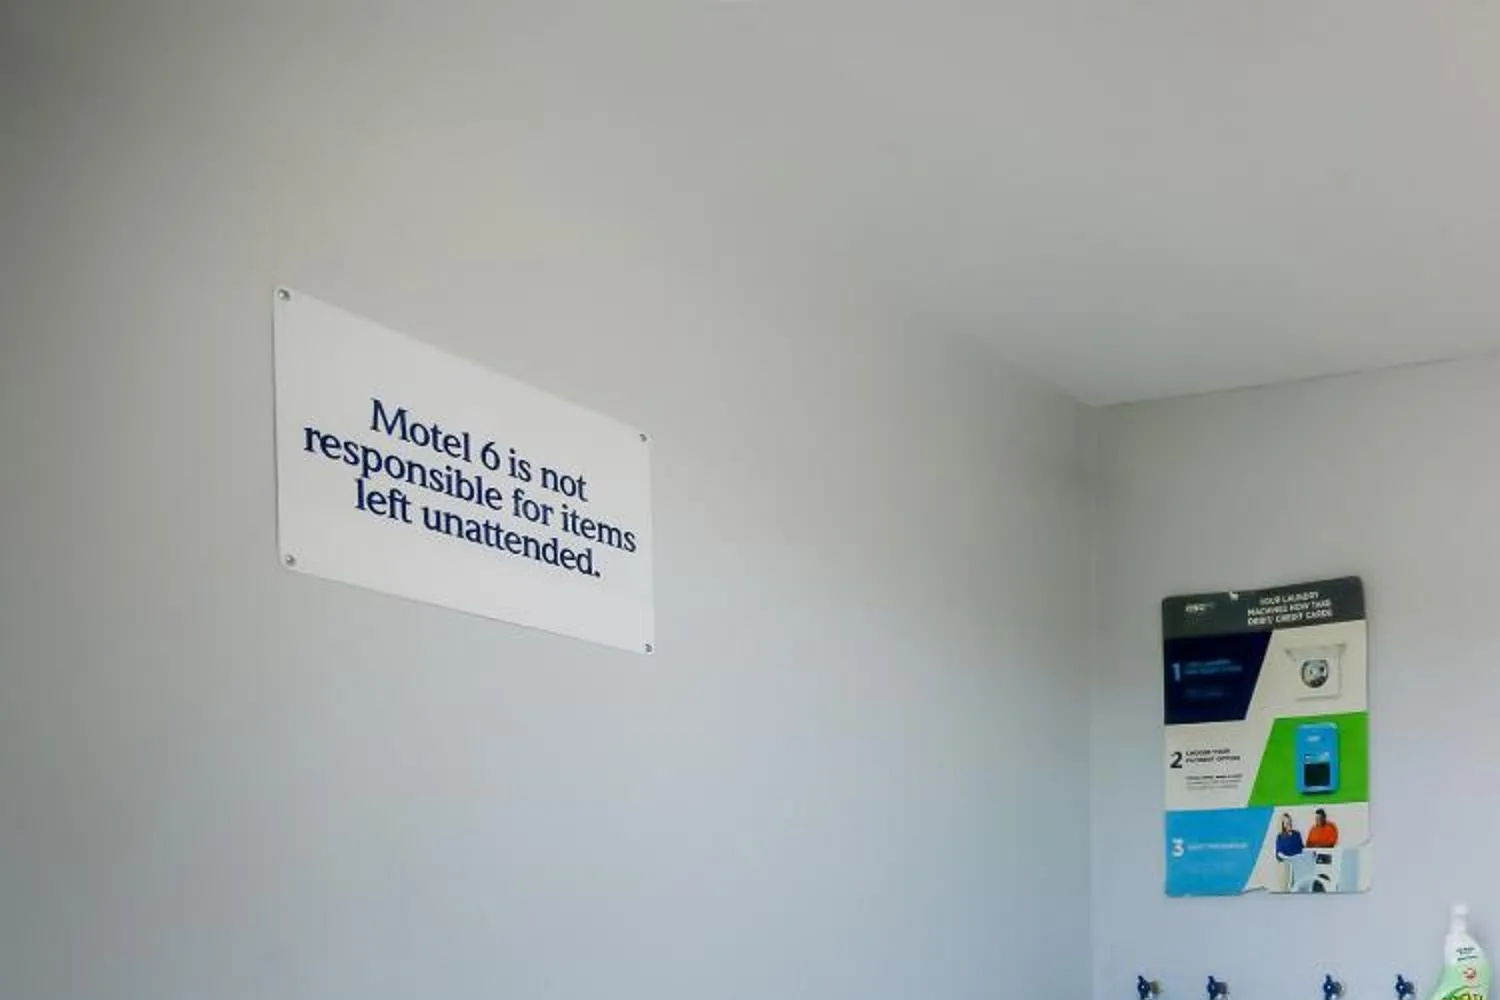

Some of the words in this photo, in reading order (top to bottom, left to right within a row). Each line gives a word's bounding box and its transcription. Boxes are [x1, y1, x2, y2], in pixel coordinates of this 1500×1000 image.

[370, 397, 471, 463] Motel
[481, 442, 501, 471] 6
[508, 449, 531, 483] is
[541, 465, 588, 502] not
[304, 426, 502, 511] responsible
[512, 489, 554, 526] for
[562, 504, 637, 553] items
[355, 478, 412, 524] left
[423, 505, 601, 578] unattended.
[1172, 662, 1181, 682] 1
[1170, 751, 1183, 769] 2
[1172, 837, 1185, 857] 3
